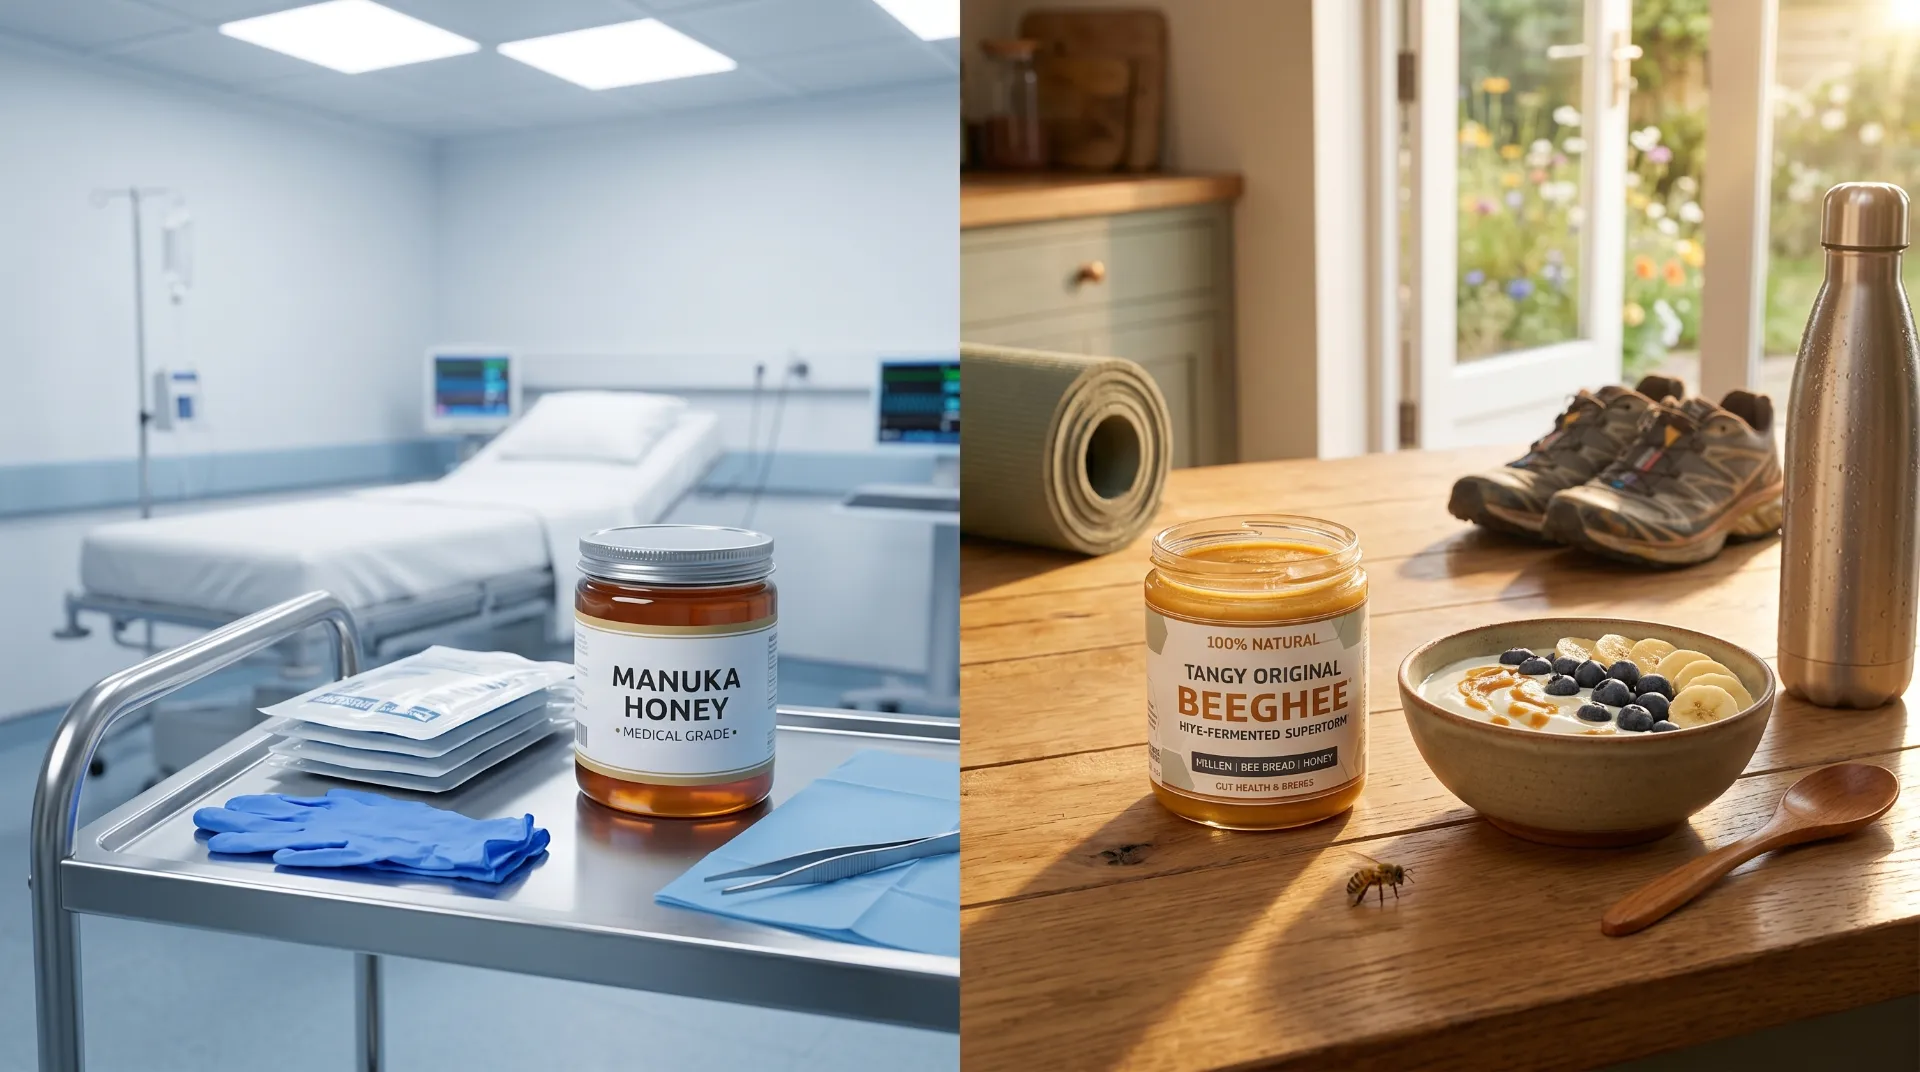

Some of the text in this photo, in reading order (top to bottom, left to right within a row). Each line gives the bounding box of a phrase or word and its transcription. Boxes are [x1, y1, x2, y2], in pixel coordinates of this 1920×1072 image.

[1207, 633, 1320, 651] 100% NATURAL
[612, 665, 741, 693] MANUKA
[1184, 660, 1341, 684] TANGY ORIGINAL
[625, 695, 729, 722] HONEY
[1178, 680, 1349, 723] BEEGHEE
[623, 726, 730, 742] MEDICAL GRADE
[1241, 762, 1260, 772] BEE
[1262, 760, 1295, 772] BREAD
[1303, 752, 1334, 768] HONEY
[1215, 778, 1314, 792] GUT HEALTH & BRERES
